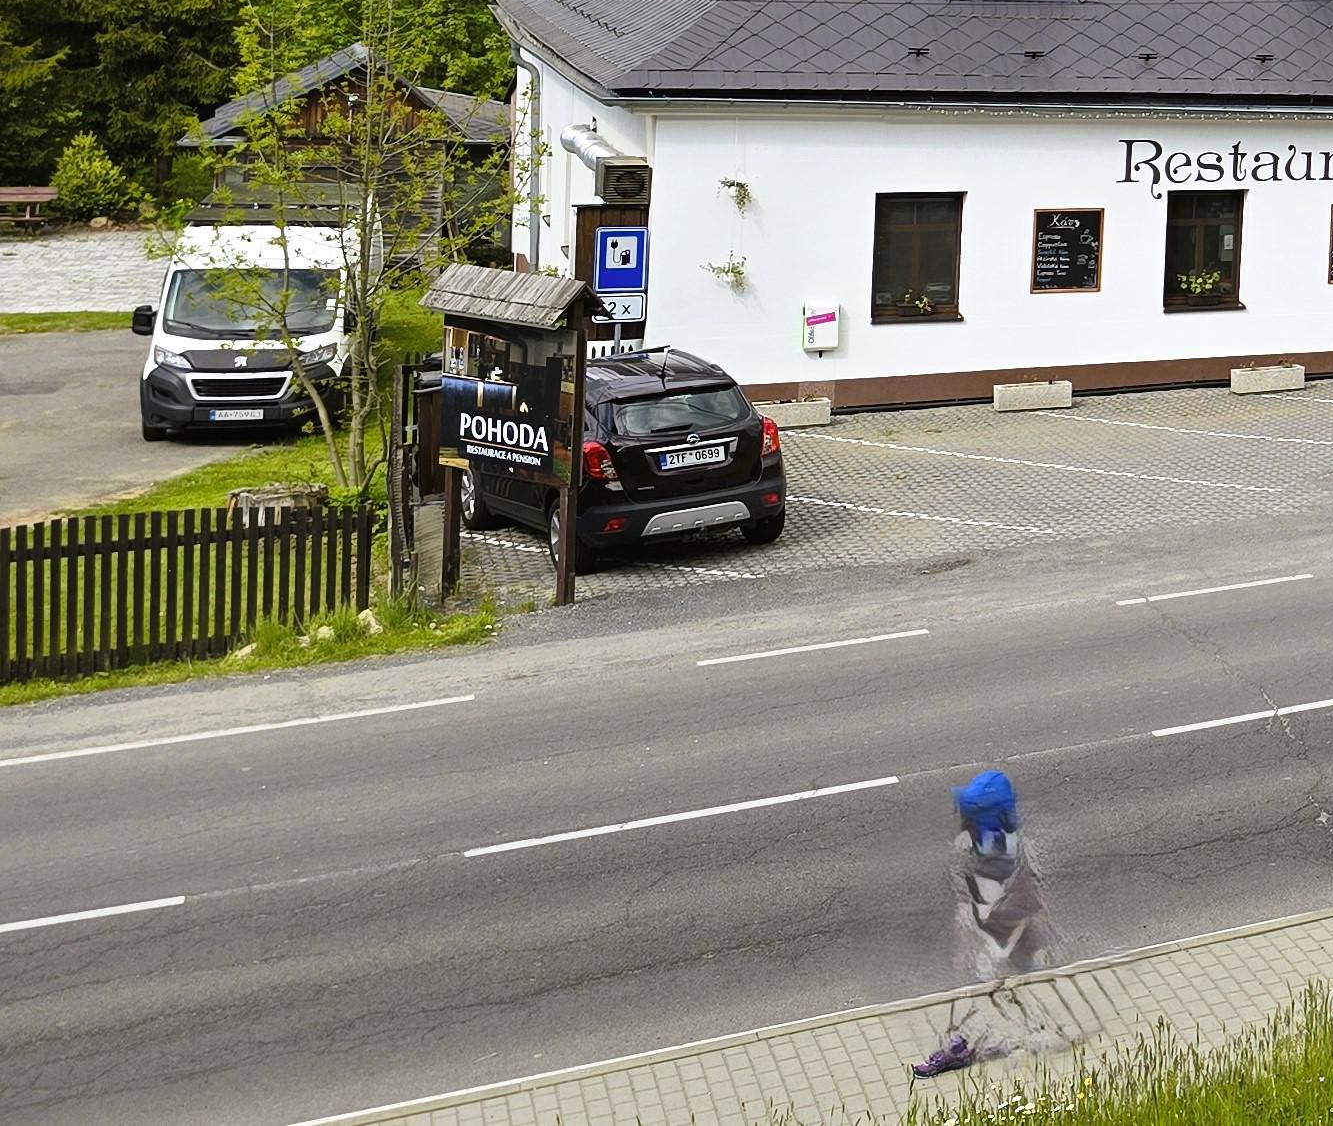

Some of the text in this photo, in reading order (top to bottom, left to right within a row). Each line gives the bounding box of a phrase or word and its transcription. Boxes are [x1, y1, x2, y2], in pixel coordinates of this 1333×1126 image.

[460, 412, 549, 452] POHODA
[466, 444, 507, 460] RESTAURACE
[512, 452, 541, 466] PENSION
[669, 448, 720, 465] 2TF 0699
